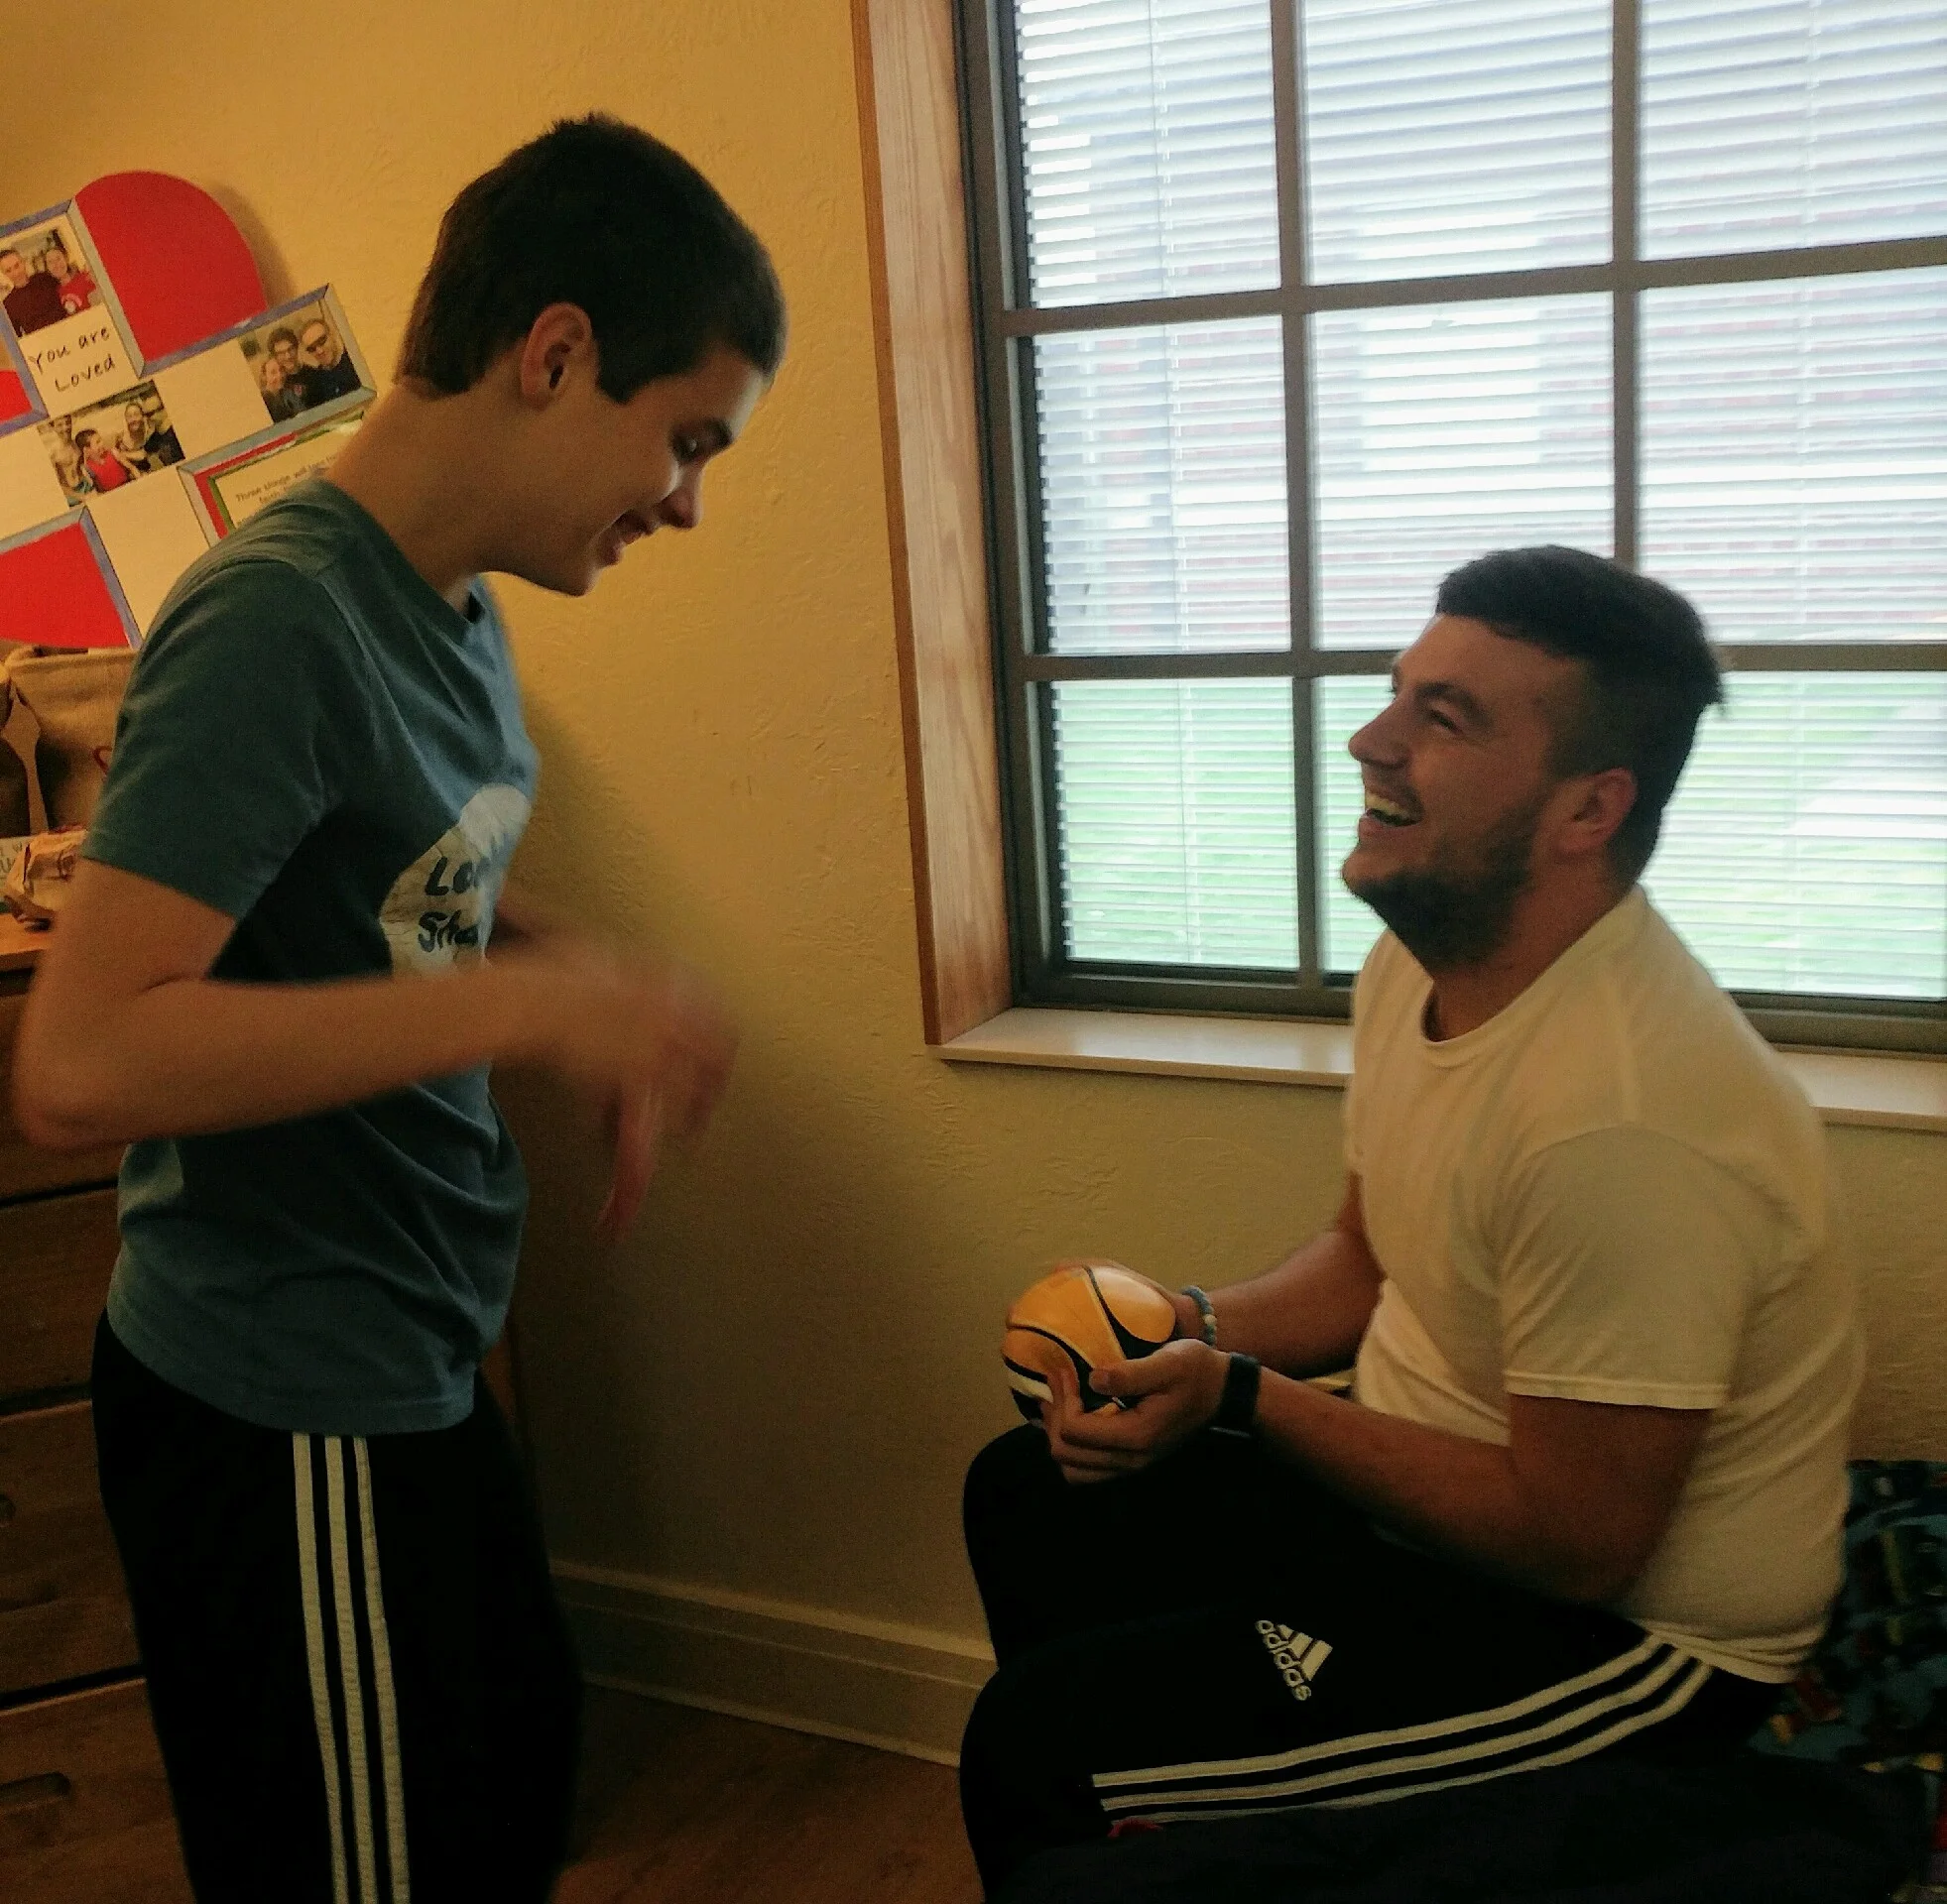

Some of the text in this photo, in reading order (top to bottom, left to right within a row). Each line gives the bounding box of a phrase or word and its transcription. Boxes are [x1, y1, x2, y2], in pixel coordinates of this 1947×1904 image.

[78, 327, 110, 350] are
[55, 353, 116, 393] Loved
[1254, 1619, 1312, 1701] adidas
